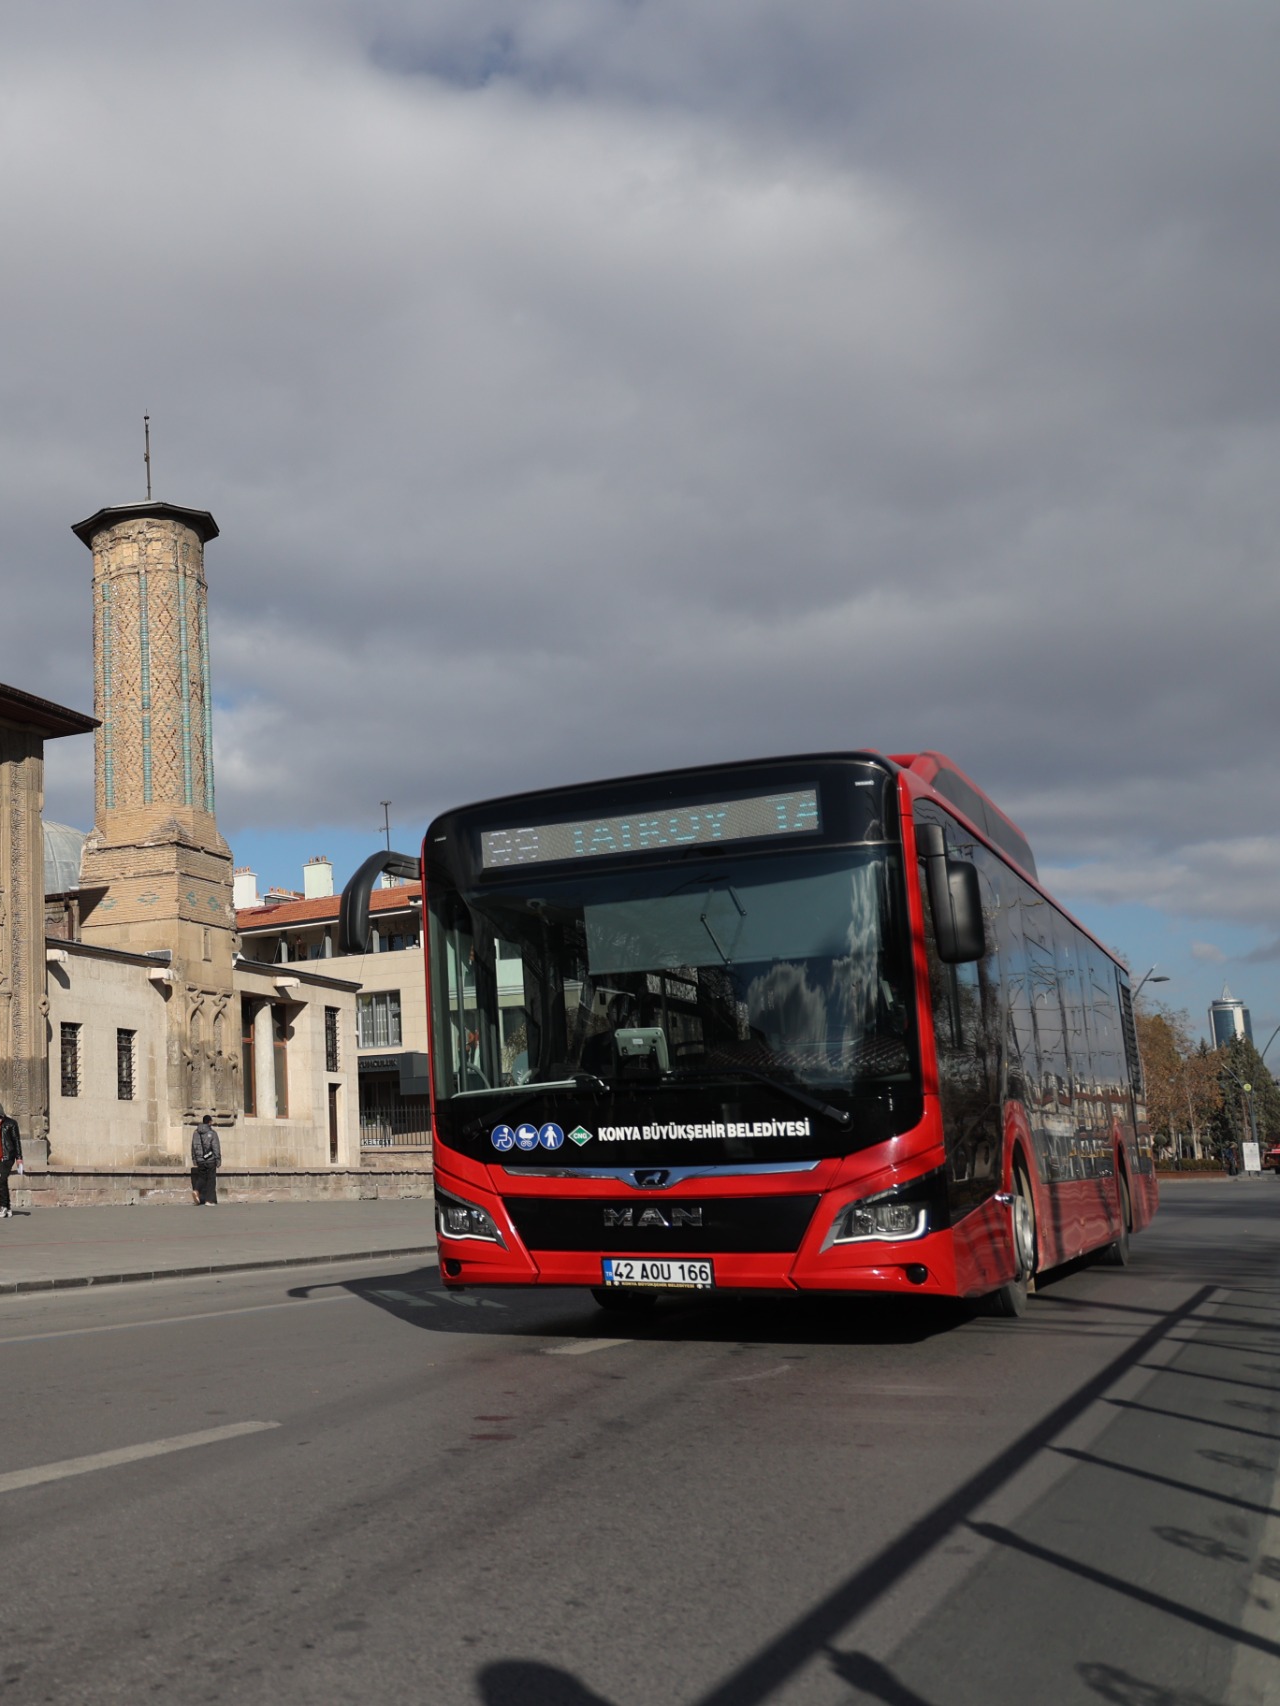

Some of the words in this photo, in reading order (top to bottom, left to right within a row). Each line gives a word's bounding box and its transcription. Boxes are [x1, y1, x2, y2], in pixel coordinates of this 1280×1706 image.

[573, 1132, 588, 1140] CNG
[598, 1126, 641, 1142] KONYA
[642, 1120, 726, 1141] BÜYÜKŞEHİR
[727, 1117, 811, 1137] BELEDİYESİ
[603, 1207, 703, 1227] MAN
[614, 1262, 635, 1280] 42
[641, 1263, 671, 1281] AOU
[678, 1264, 709, 1282] 166
